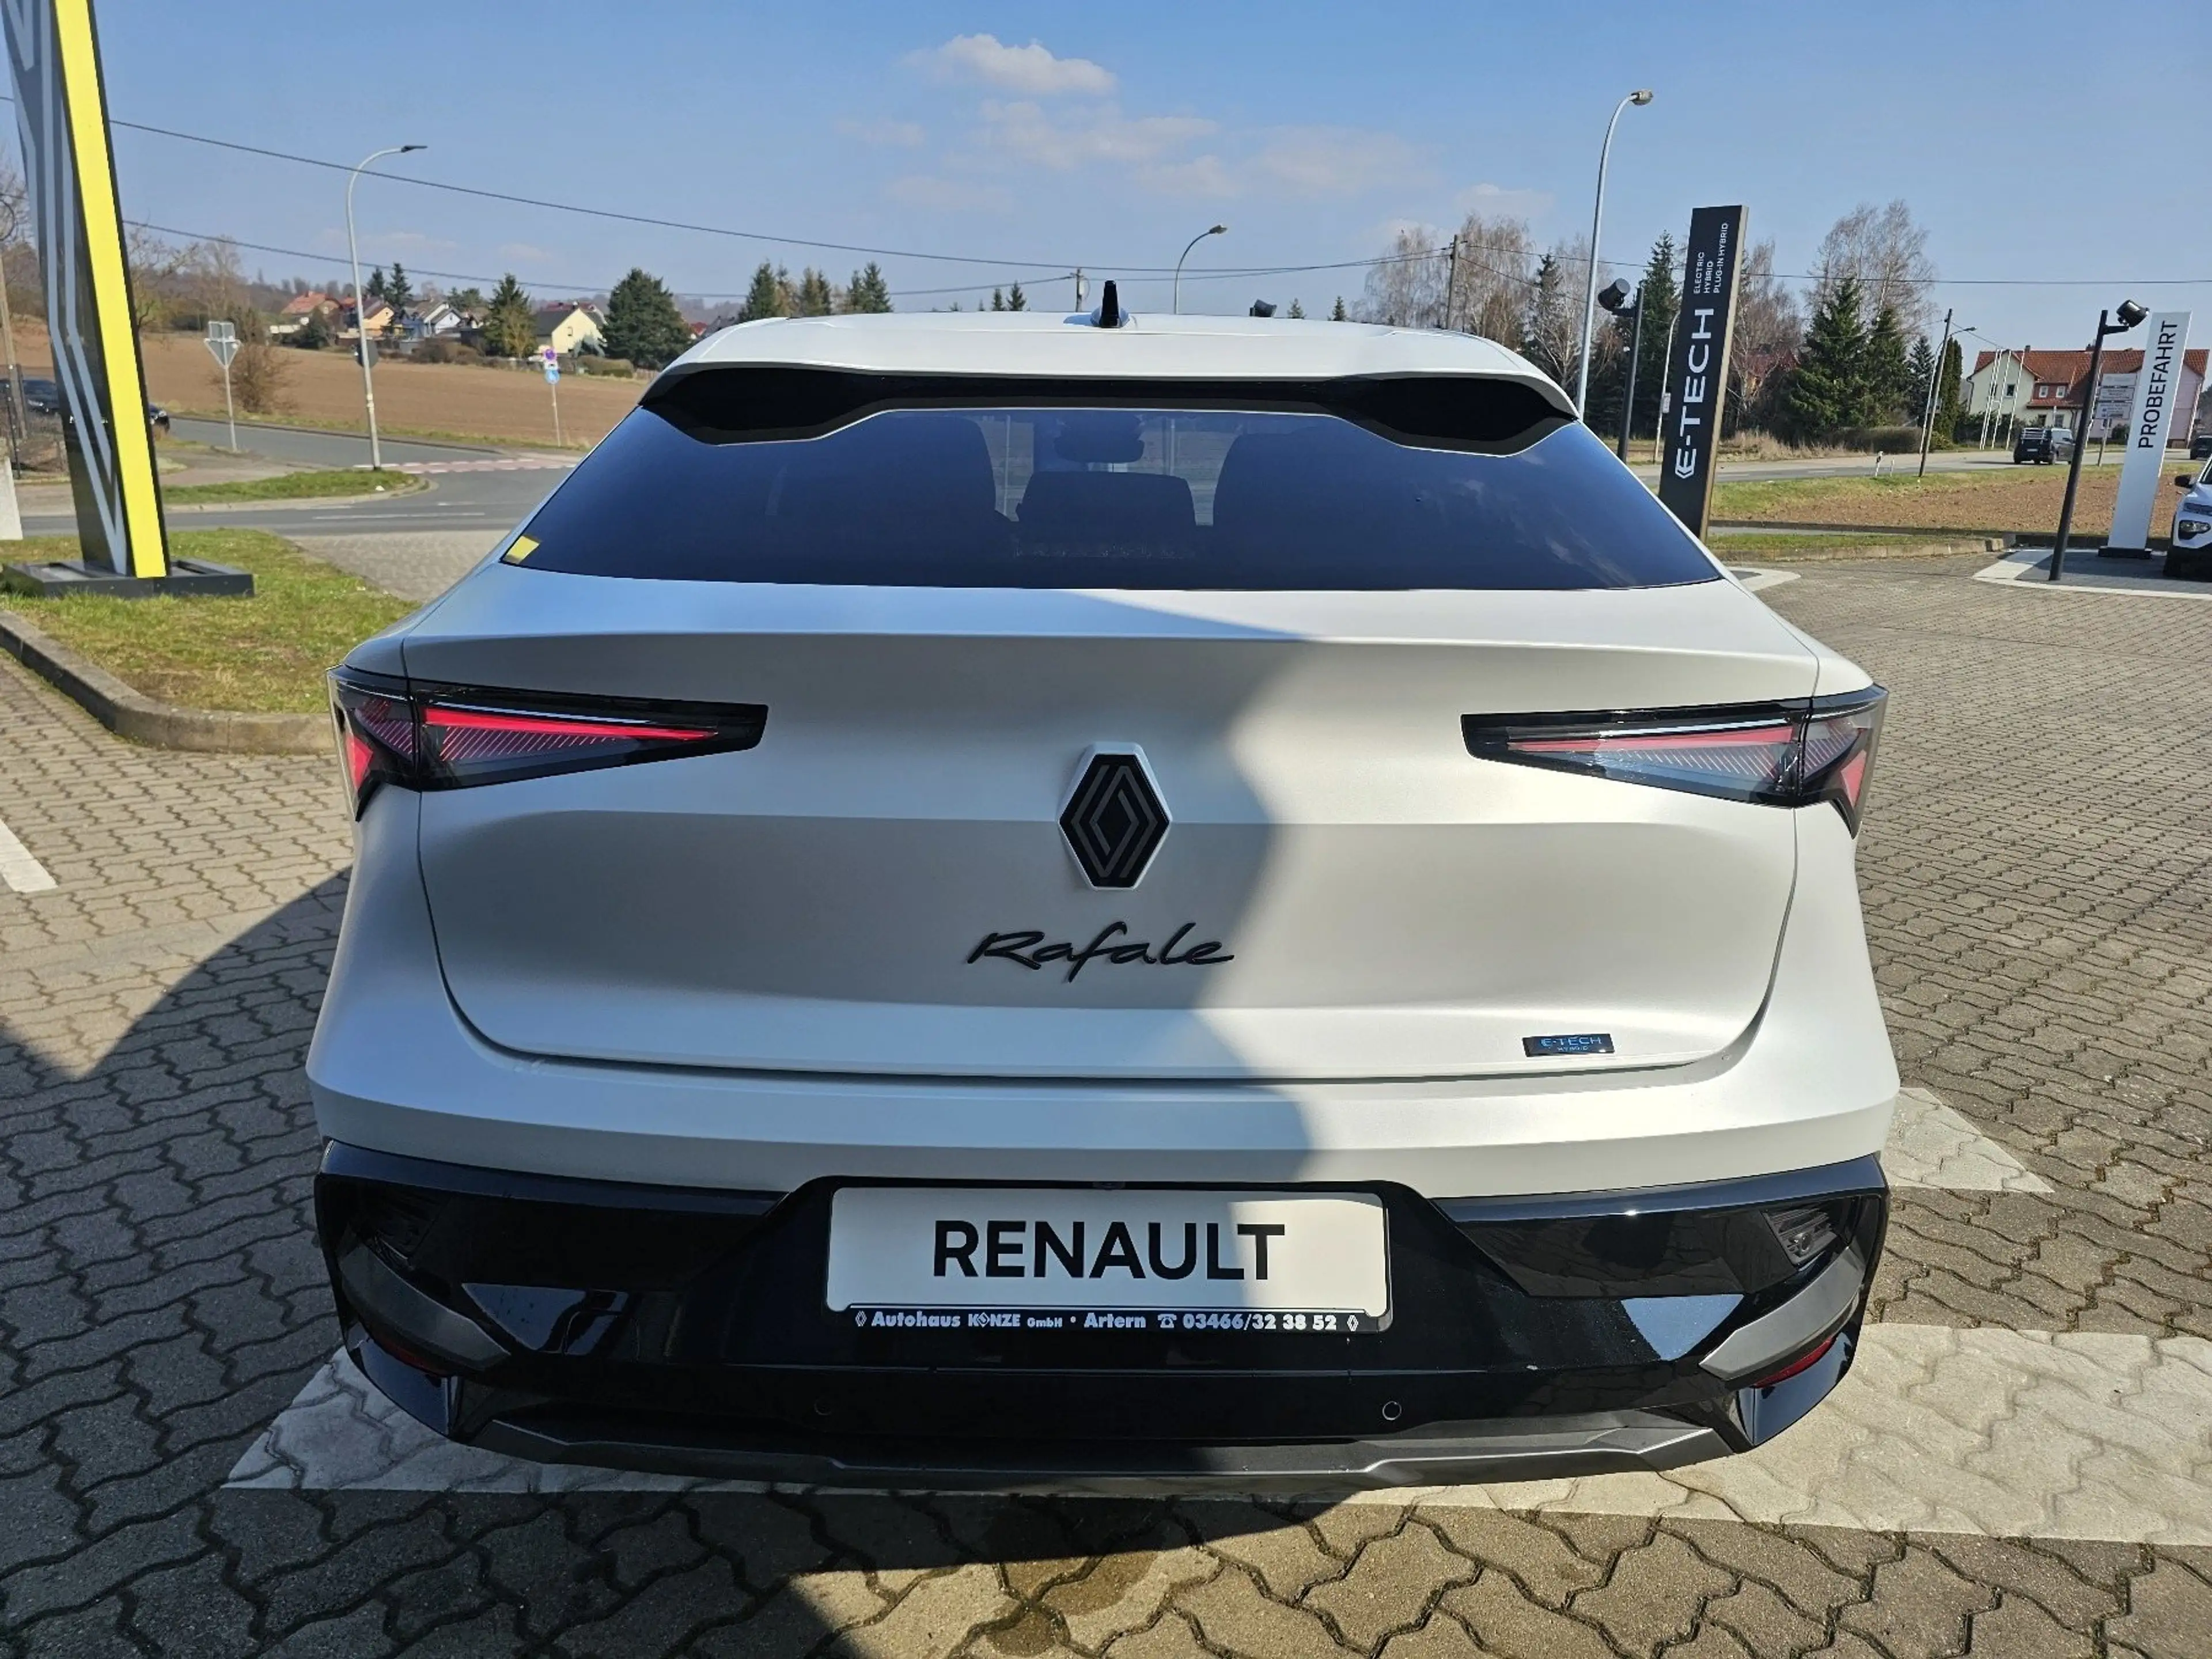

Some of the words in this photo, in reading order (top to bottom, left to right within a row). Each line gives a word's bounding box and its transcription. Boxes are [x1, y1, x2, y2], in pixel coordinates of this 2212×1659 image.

[1718, 222, 1729, 256] HYBRID
[1694, 252, 1705, 294] ELECTRIC
[1703, 260, 1714, 294] HYBRID
[1713, 257, 1724, 293] PLUG-IN
[1675, 308, 1714, 479] E-TECH
[2138, 320, 2178, 449] PROBEFAHRT
[967, 921, 1234, 983] Rafale
[1540, 1036, 1602, 1047] E-TECH
[934, 1220, 1285, 1279] RENAULT
[871, 1311, 960, 1327] Autohaus
[1027, 1317, 1063, 1328] GmbH
[1084, 1313, 1146, 1329] Artern
[1183, 1314, 1277, 1331] 03466/32
[1283, 1315, 1306, 1330] 38
[1312, 1315, 1337, 1331] 52
